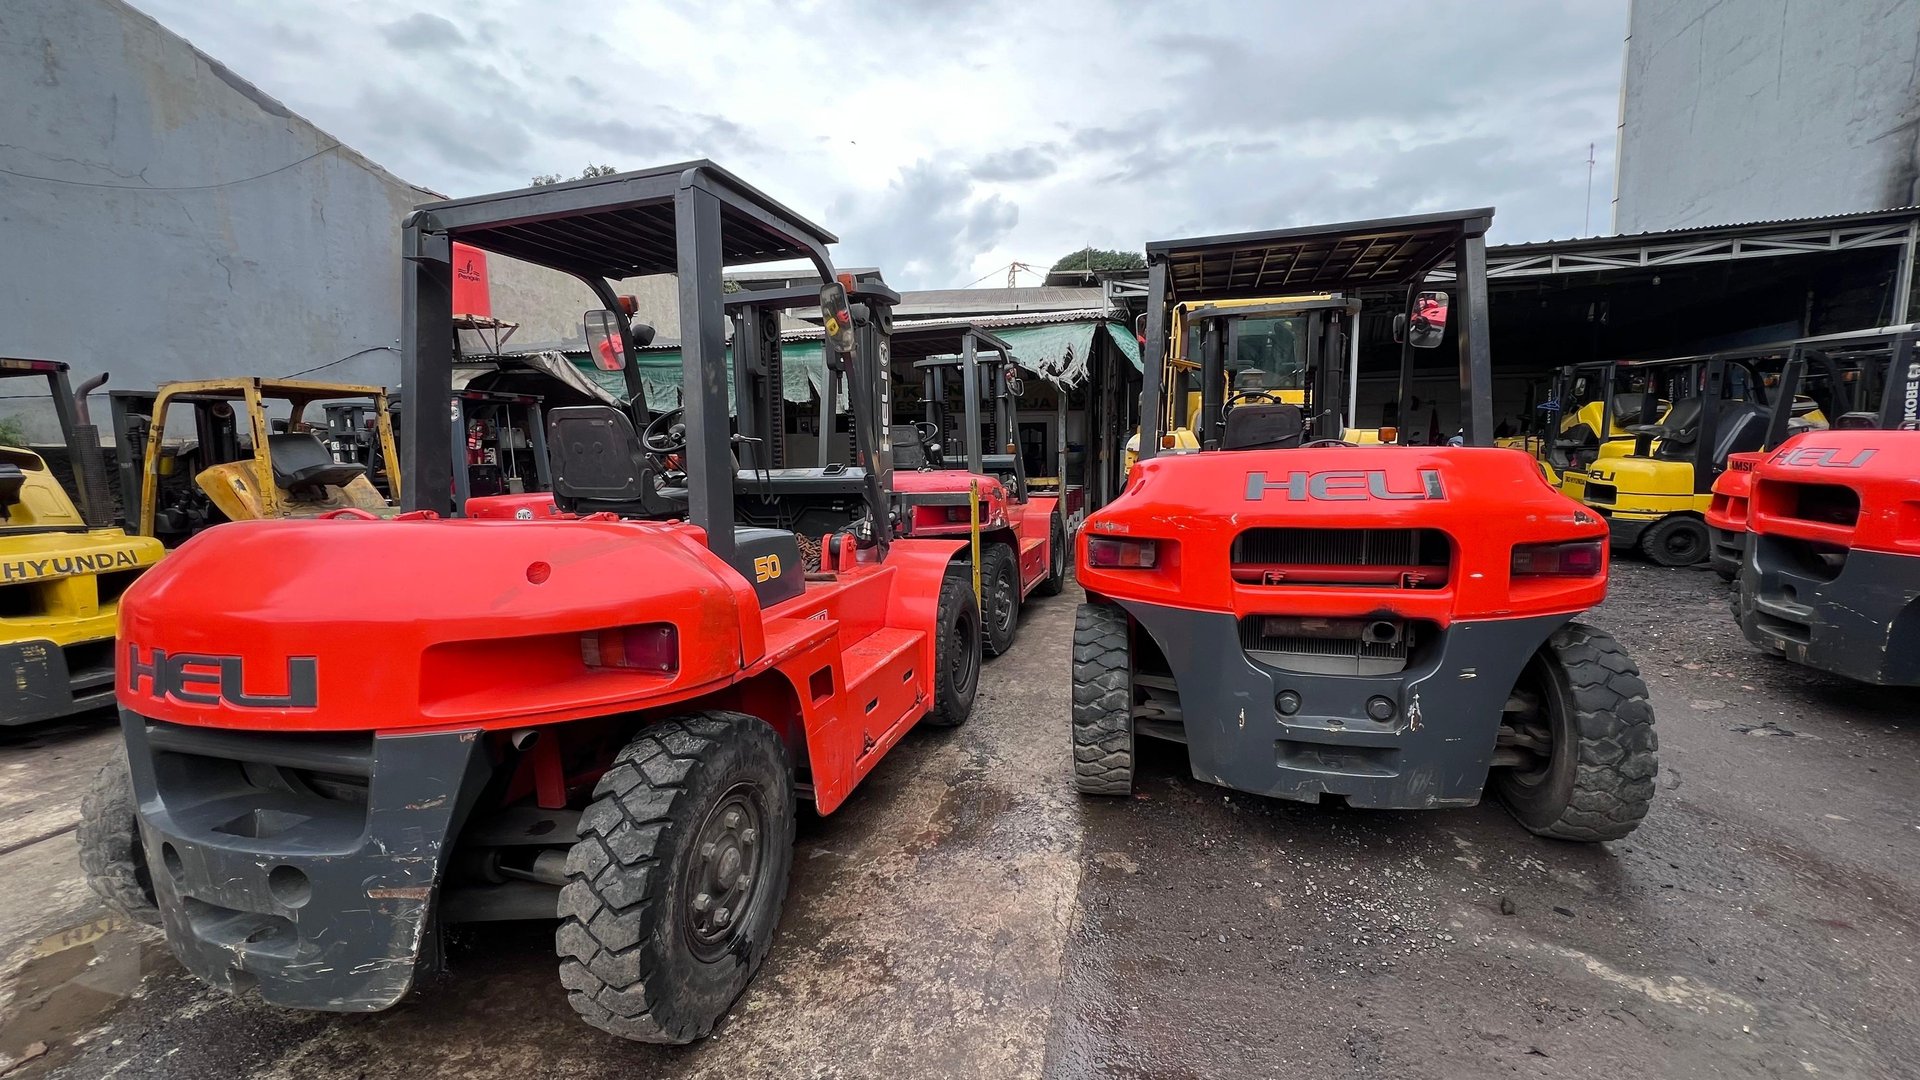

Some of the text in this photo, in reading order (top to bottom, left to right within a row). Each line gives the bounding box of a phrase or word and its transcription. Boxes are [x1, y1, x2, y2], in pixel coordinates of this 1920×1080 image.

[1768, 447, 1880, 468] HELI
[1245, 470, 1447, 501] HELI
[4, 550, 138, 578] HYUNDAI
[754, 554, 781, 583] 50
[129, 643, 318, 709] HELI
